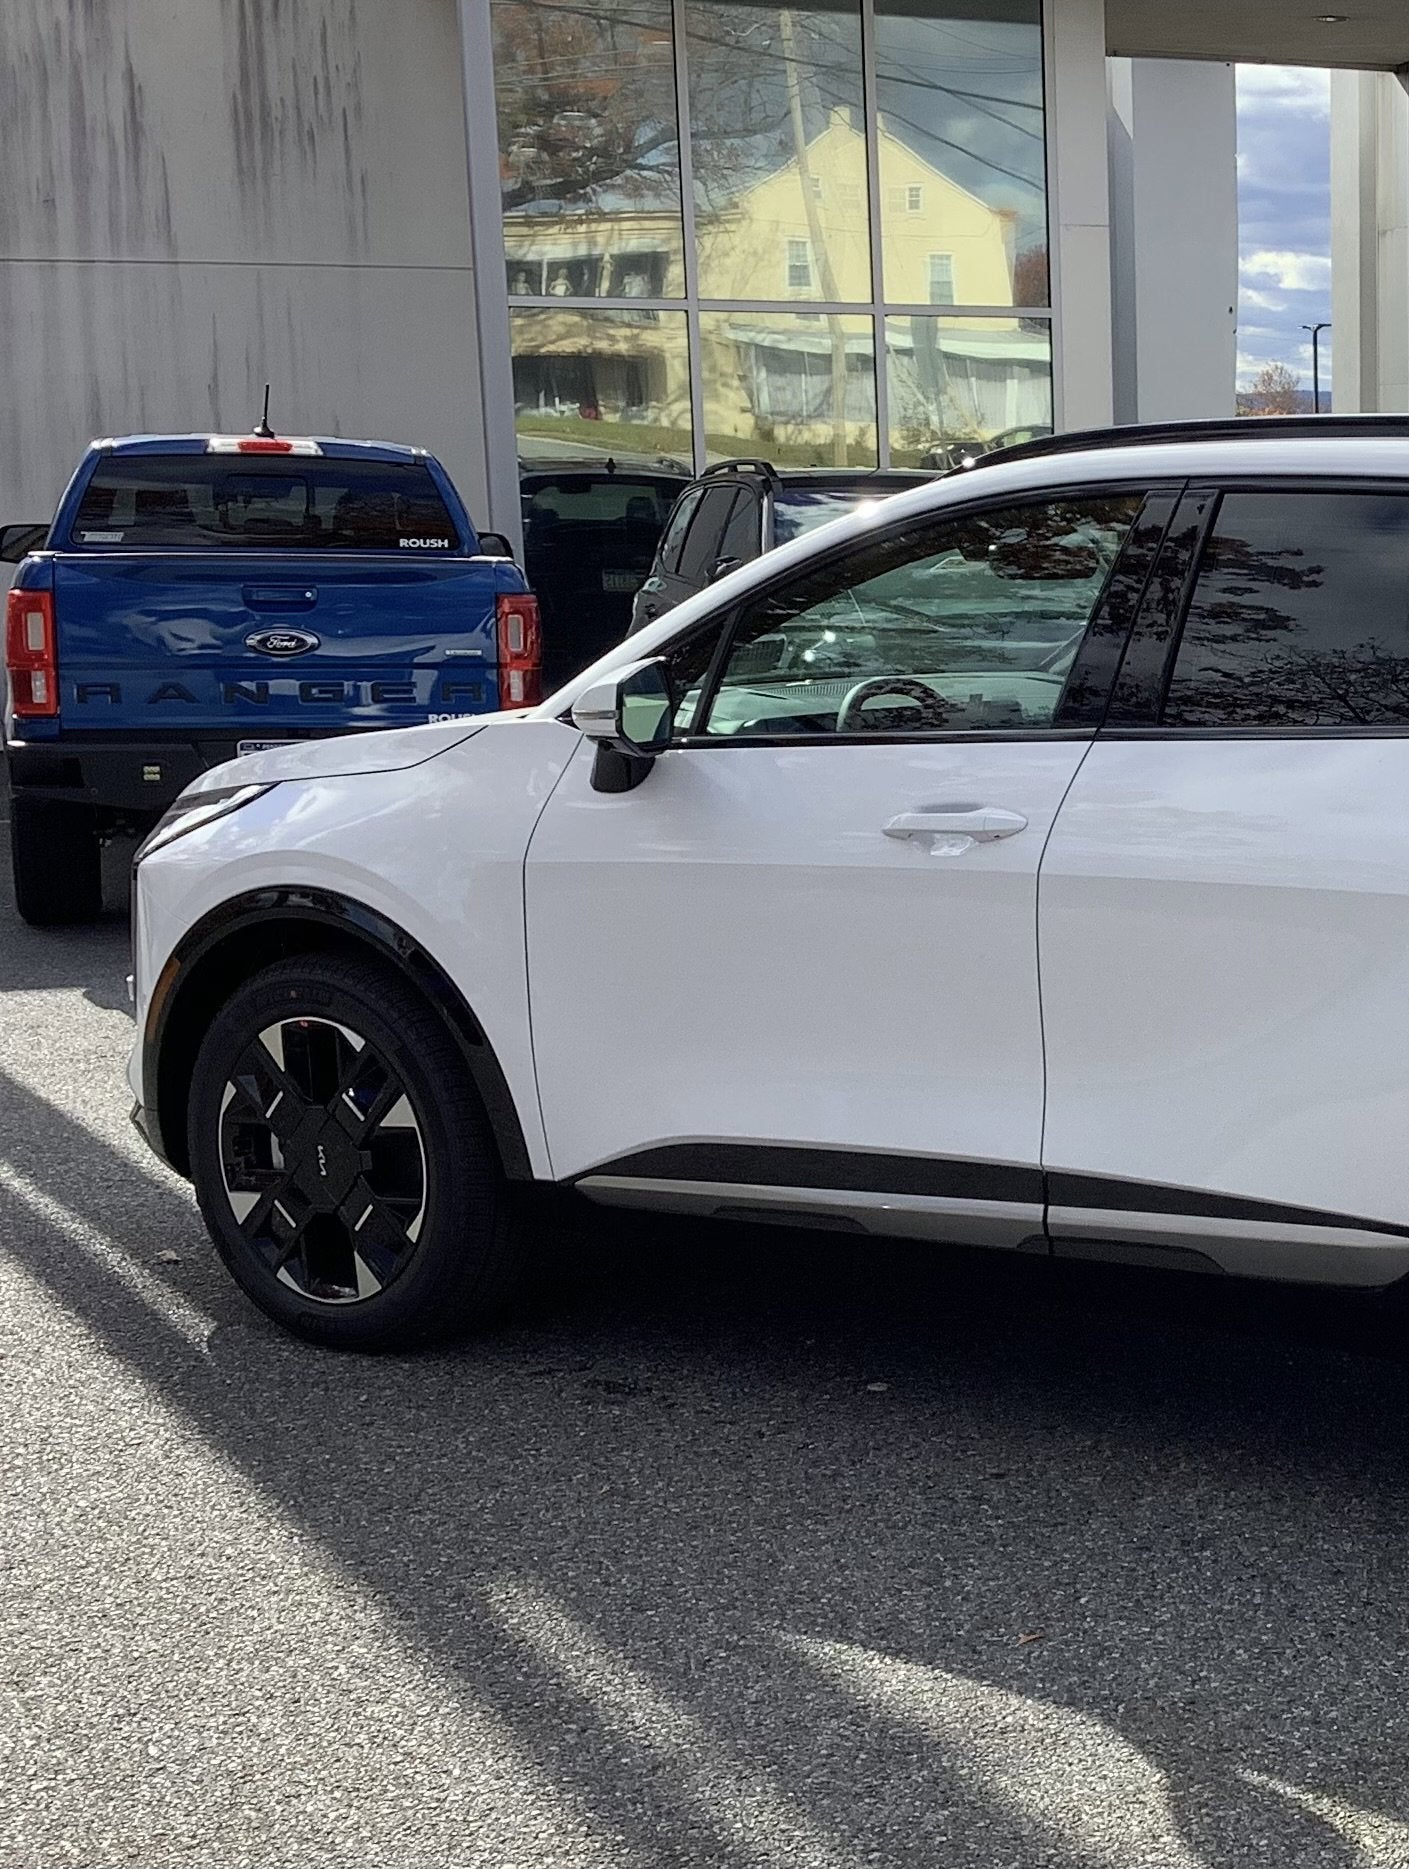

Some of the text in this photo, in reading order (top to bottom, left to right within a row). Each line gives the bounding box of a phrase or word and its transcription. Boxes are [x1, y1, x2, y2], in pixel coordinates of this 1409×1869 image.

[399, 538, 449, 548] ROUSH
[266, 635, 298, 649] Ford
[74, 680, 485, 705] RANGER
